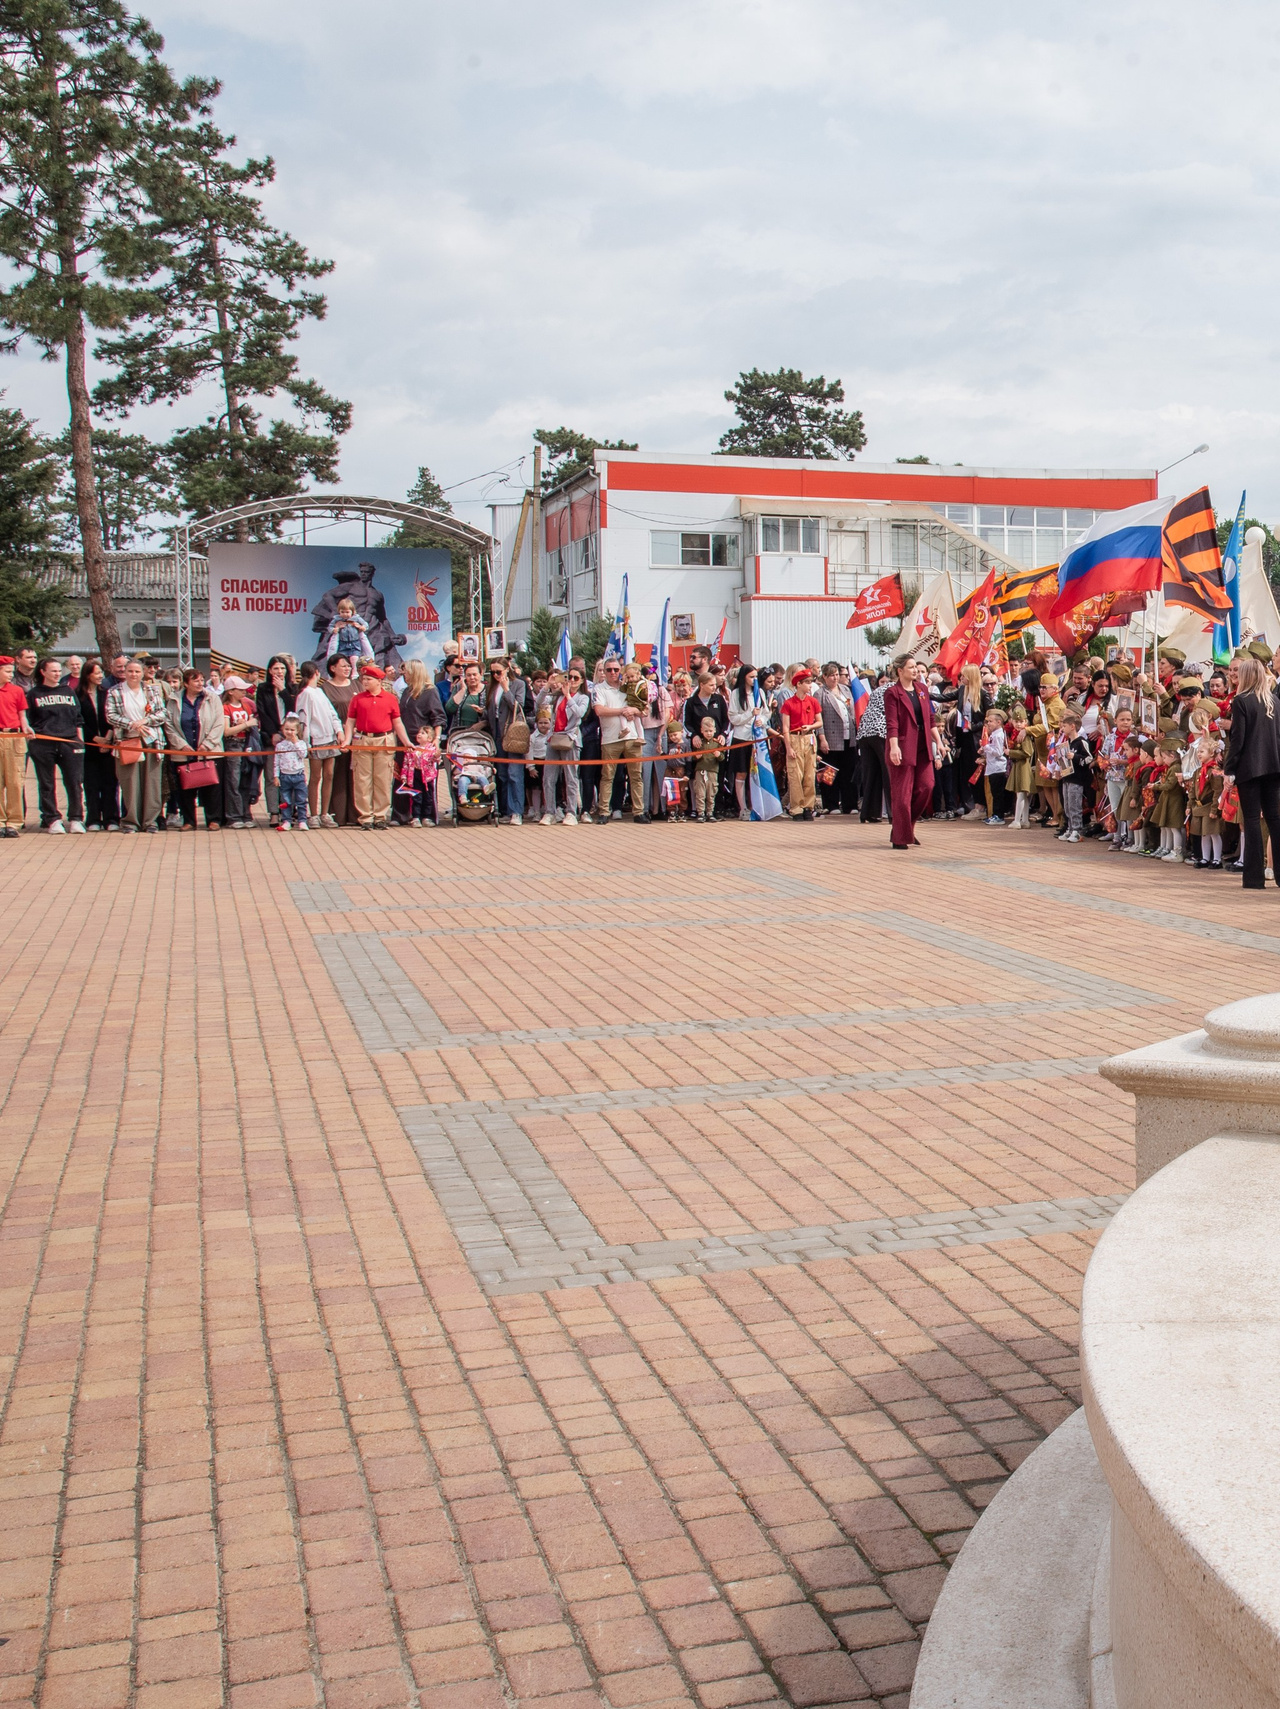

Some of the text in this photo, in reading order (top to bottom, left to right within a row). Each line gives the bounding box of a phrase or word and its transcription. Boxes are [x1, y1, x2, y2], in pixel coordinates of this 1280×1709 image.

[221, 579, 288, 594] СПАСИБО
[221, 597, 307, 614] ЗА ПОБЕДУ!
[408, 606, 425, 621] 80
[408, 623, 440, 632] ПОБЕДА!
